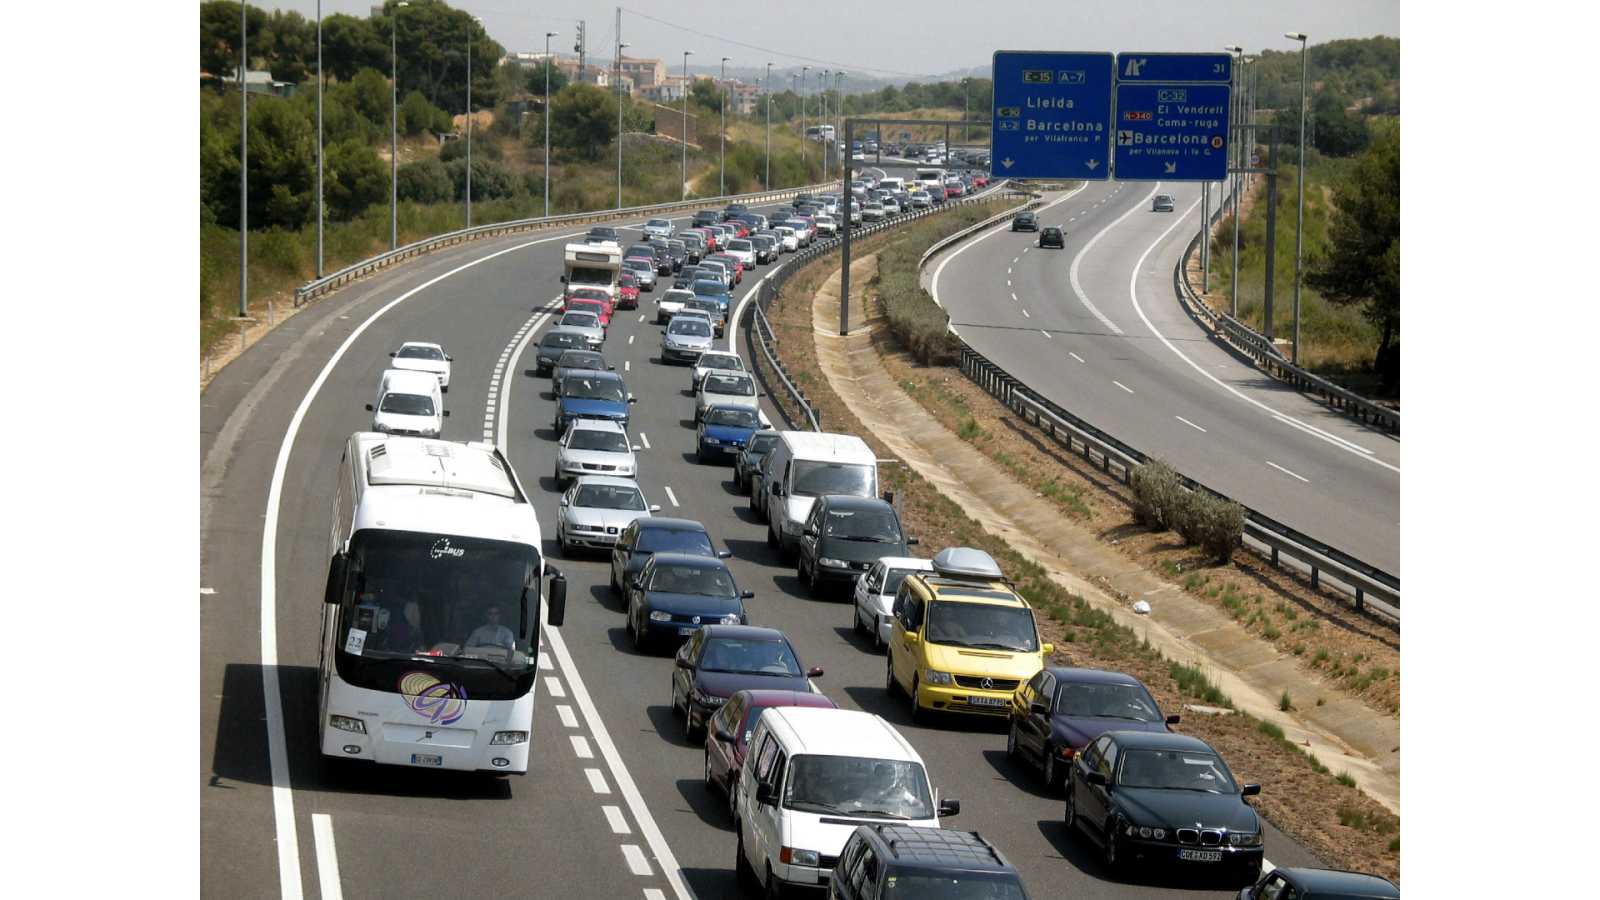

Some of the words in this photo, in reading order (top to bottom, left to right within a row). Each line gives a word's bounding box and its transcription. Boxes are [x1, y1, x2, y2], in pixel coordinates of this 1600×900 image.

[1213, 64, 1225, 73] 31
[1024, 72, 1050, 81] E-15
[1060, 72, 1084, 82] A-7
[1160, 91, 1185, 100] C-32
[1027, 96, 1074, 108] Lleida
[1158, 105, 1168, 114] El
[1177, 106, 1223, 114] Vendrell
[1027, 120, 1103, 131] Barcelona
[1158, 119, 1218, 128] Coma-ruga
[1134, 132, 1208, 144] Barcelona
[348, 636, 362, 648] 22
